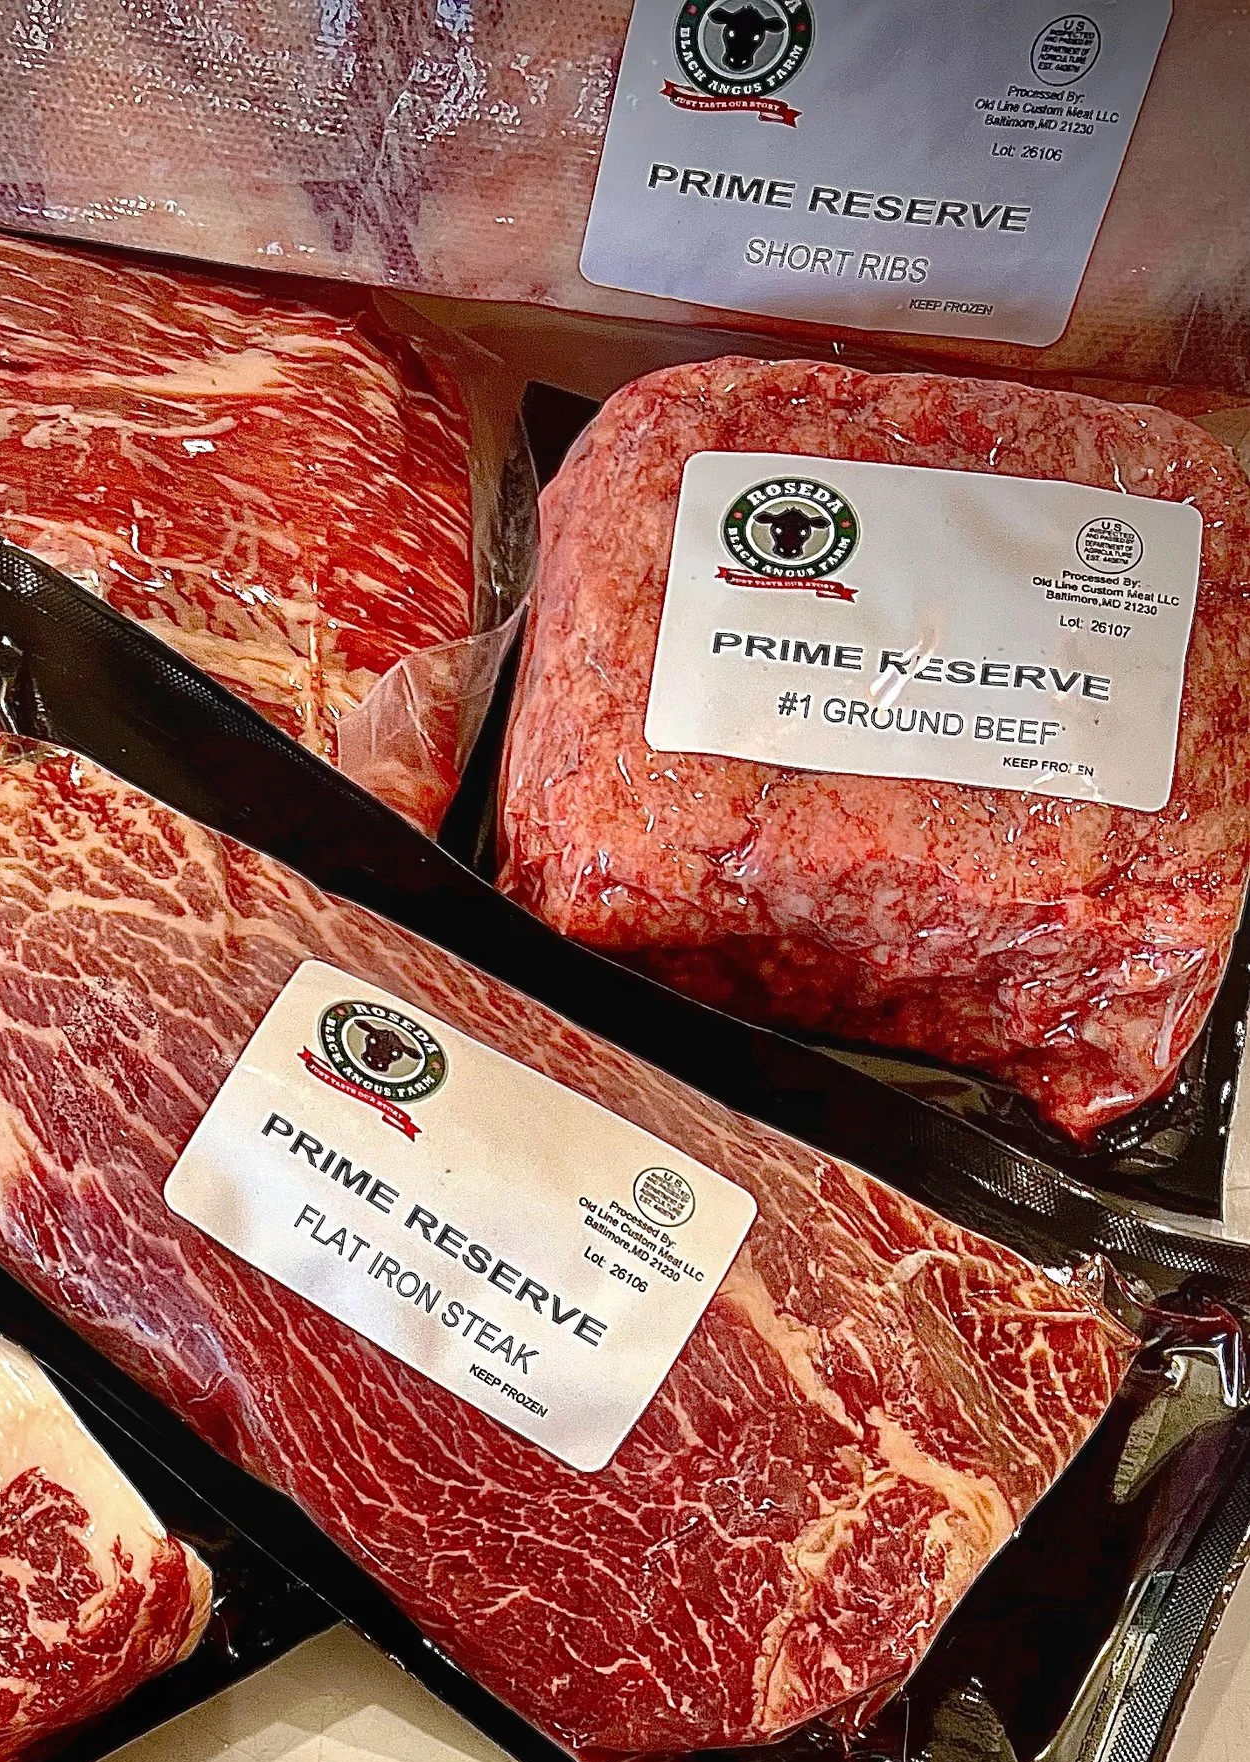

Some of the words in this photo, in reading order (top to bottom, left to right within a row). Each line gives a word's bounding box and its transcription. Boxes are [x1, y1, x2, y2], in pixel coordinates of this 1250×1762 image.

[680, 27, 707, 82] BLACK
[708, 79, 762, 95] ANGUS
[767, 45, 803, 86] FARM
[1059, 121, 1094, 135] 21230
[1021, 146, 1062, 161] 26106
[648, 164, 795, 208] PRIME
[809, 187, 1031, 232] RESERVE
[746, 239, 854, 276] SHORT
[858, 254, 928, 288] RIBS
[909, 299, 944, 312] KEEP
[944, 301, 993, 315] FROZEN
[746, 481, 846, 515] ROSEDA
[1063, 570, 1120, 585] Processed
[1124, 601, 1157, 615] 21230
[1060, 615, 1084, 629] Lot:
[1091, 620, 1131, 638] 26107
[713, 632, 863, 670] PRIME
[878, 650, 1112, 701] RESERVE
[778, 692, 811, 718] #1
[824, 698, 963, 736] GROUND
[974, 716, 1059, 745] BEEF
[1003, 757, 1038, 769] KEEP
[353, 1001, 441, 1056] ROSEDA
[261, 1113, 399, 1213] PRIME
[404, 1205, 607, 1347] RESERVE
[609, 1201, 660, 1238] Processed
[609, 1264, 648, 1292] 26106
[649, 1258, 680, 1281] 21230
[294, 1204, 370, 1262] FLAT
[367, 1251, 442, 1313] IRON
[442, 1302, 539, 1374] STEAK
[469, 1364, 502, 1391] KEEP
[501, 1383, 548, 1417] FROZEN
